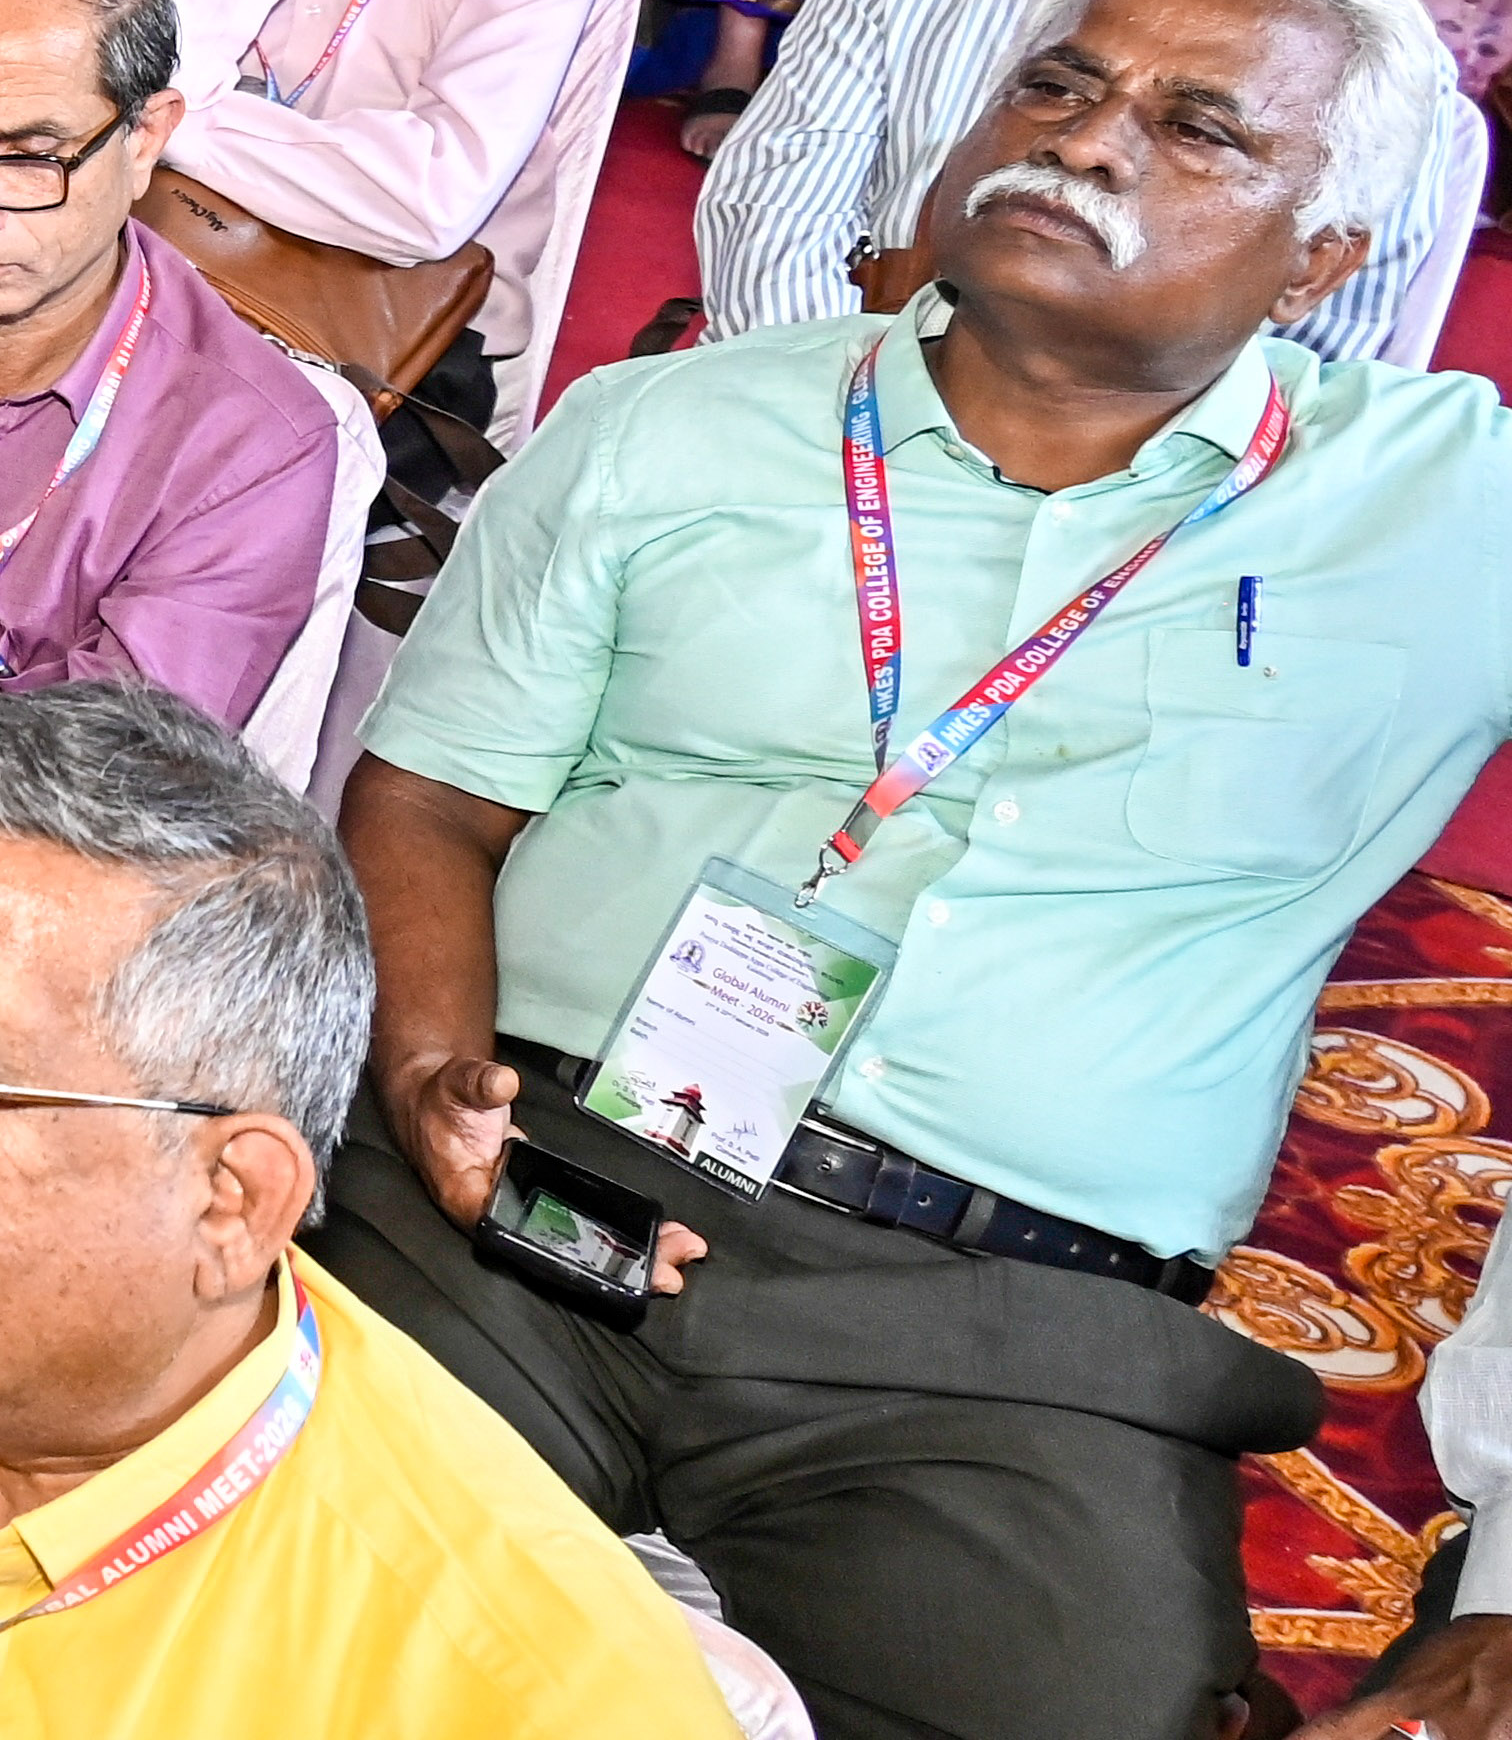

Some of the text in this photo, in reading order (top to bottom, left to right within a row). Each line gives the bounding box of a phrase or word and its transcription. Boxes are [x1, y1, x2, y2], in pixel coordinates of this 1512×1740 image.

[850, 408, 894, 716] HKES' PDA COLLEGE OF ENGINEERING
[943, 697, 990, 746] HKES'
[985, 670, 1026, 710] PDA
[1014, 605, 1089, 677] COLLEGE
[1079, 588, 1107, 614] OF
[1215, 453, 1267, 506] GLOBAL
[710, 985, 739, 1009] Meet
[746, 1002, 776, 1026] 2026
[712, 966, 750, 993] Global
[749, 985, 790, 1013] Alumni
[699, 1157, 757, 1196] ALUMNI
[99, 1509, 198, 1586] ALUMNI
[192, 1394, 304, 1521] MEET-2026
